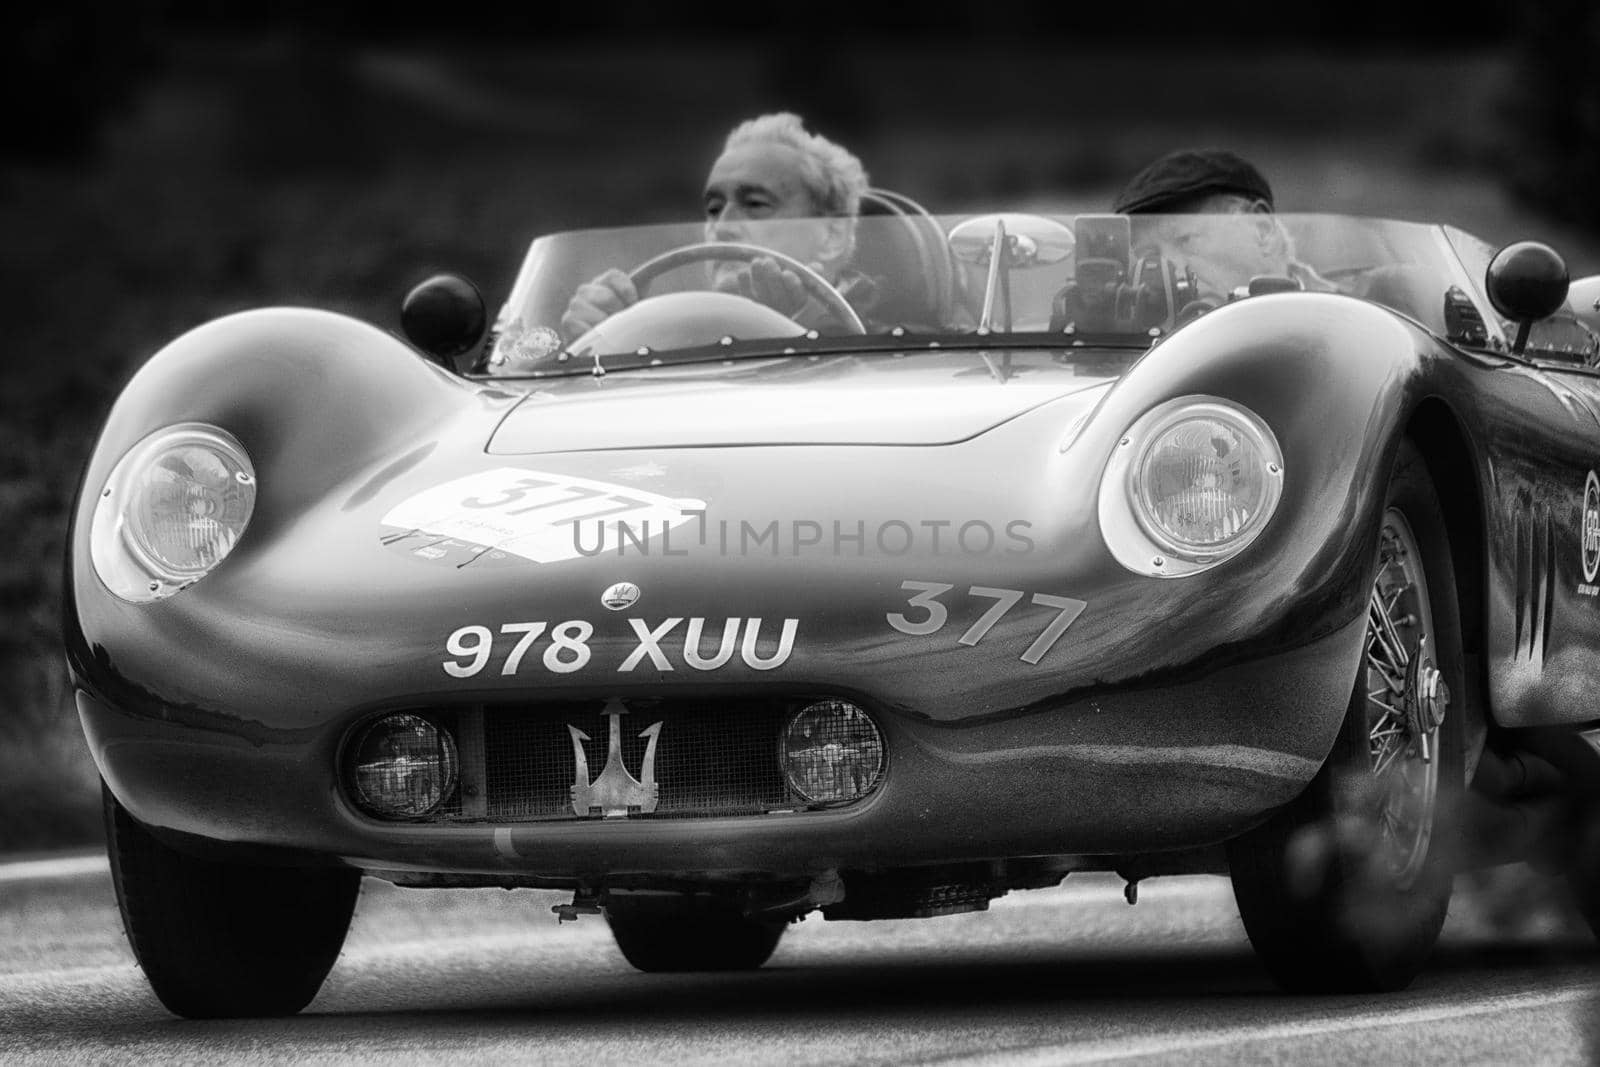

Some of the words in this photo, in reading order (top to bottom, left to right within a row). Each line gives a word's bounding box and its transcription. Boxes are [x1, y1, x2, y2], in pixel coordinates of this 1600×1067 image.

[460, 478, 654, 526] 377
[443, 620, 594, 678] 978
[616, 617, 800, 671] XUU
[886, 580, 1088, 665] 377
